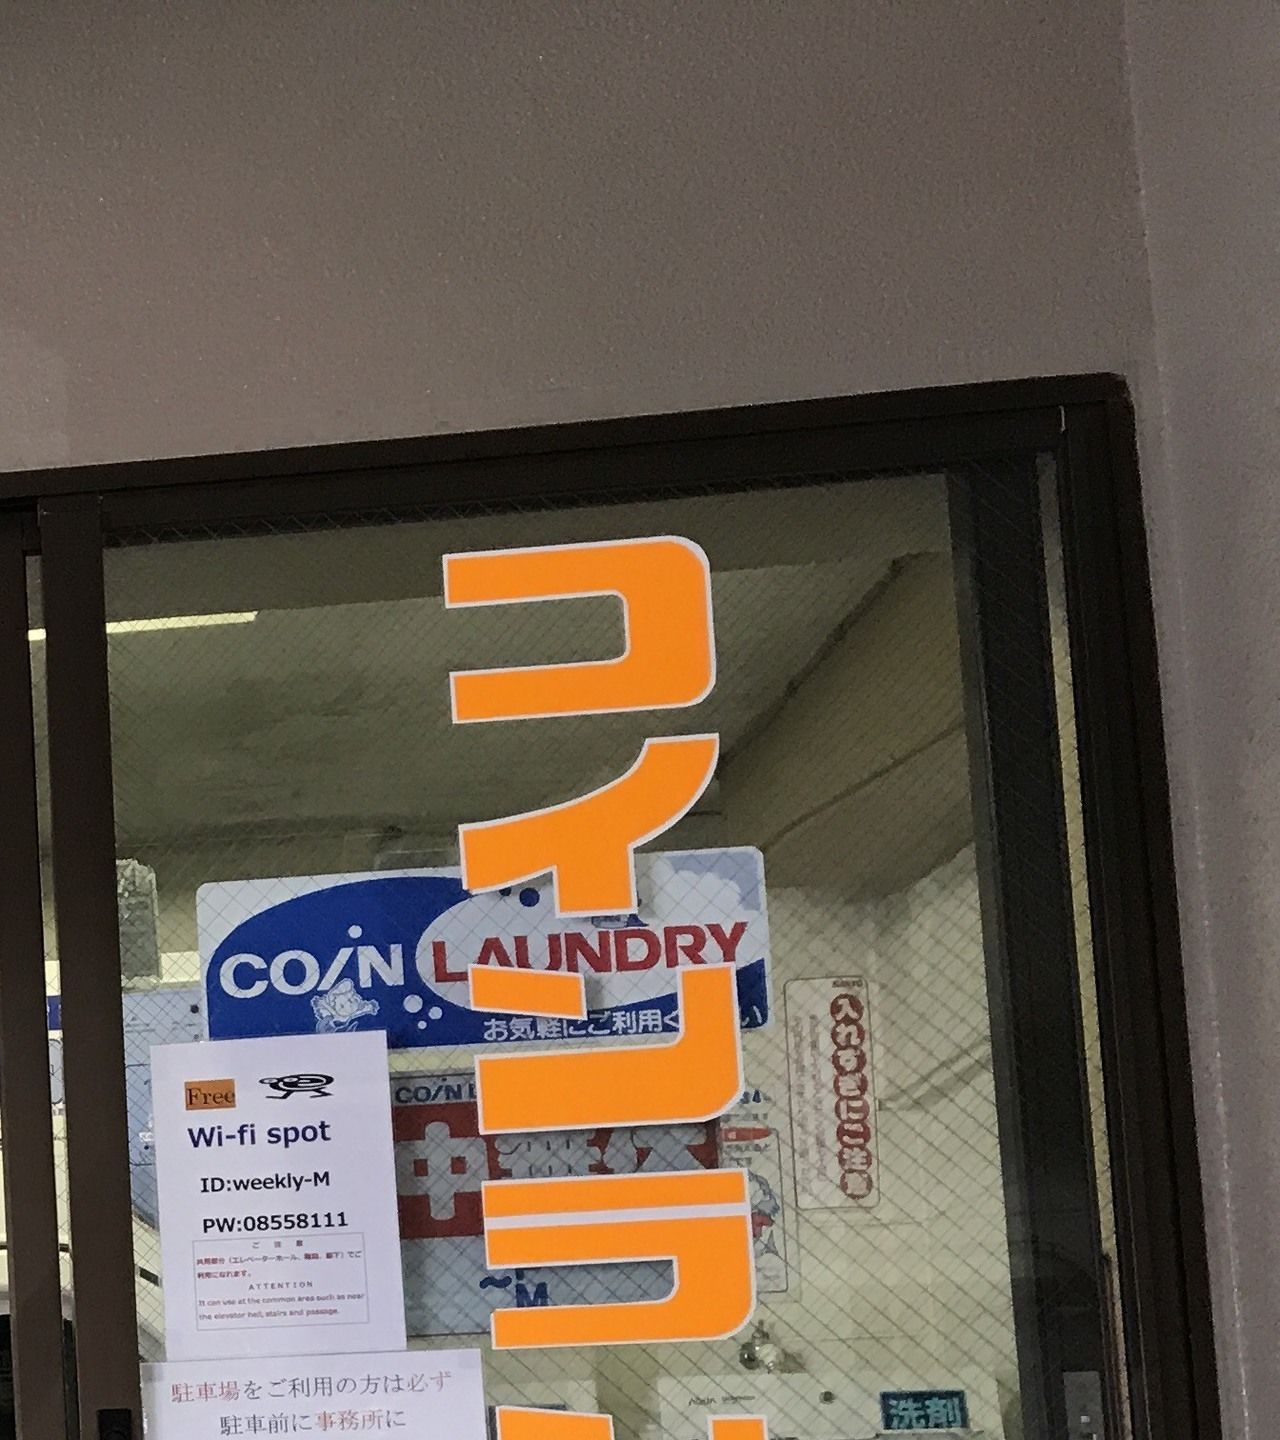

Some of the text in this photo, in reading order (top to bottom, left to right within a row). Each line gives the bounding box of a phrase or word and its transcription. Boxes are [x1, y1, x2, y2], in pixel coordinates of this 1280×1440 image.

[221, 921, 748, 999] COIN LAUNDRY
[484, 1006, 764, 1042] お気軽にご利用くい
[188, 1088, 235, 1106] Free
[188, 1120, 331, 1148] Wi-fi spot
[200, 1171, 330, 1193] ID:weekly-M
[203, 1212, 348, 1233] PW:08558111
[248, 1281, 313, 1291] ATTENTION
[199, 1313, 212, 1321] the
[265, 1309, 287, 1317] stairs
[171, 1370, 452, 1403] 駐車場をご利用の方は必ず
[220, 1408, 407, 1436] 駐車前に事務所に
[889, 1397, 962, 1430] 洗剤
